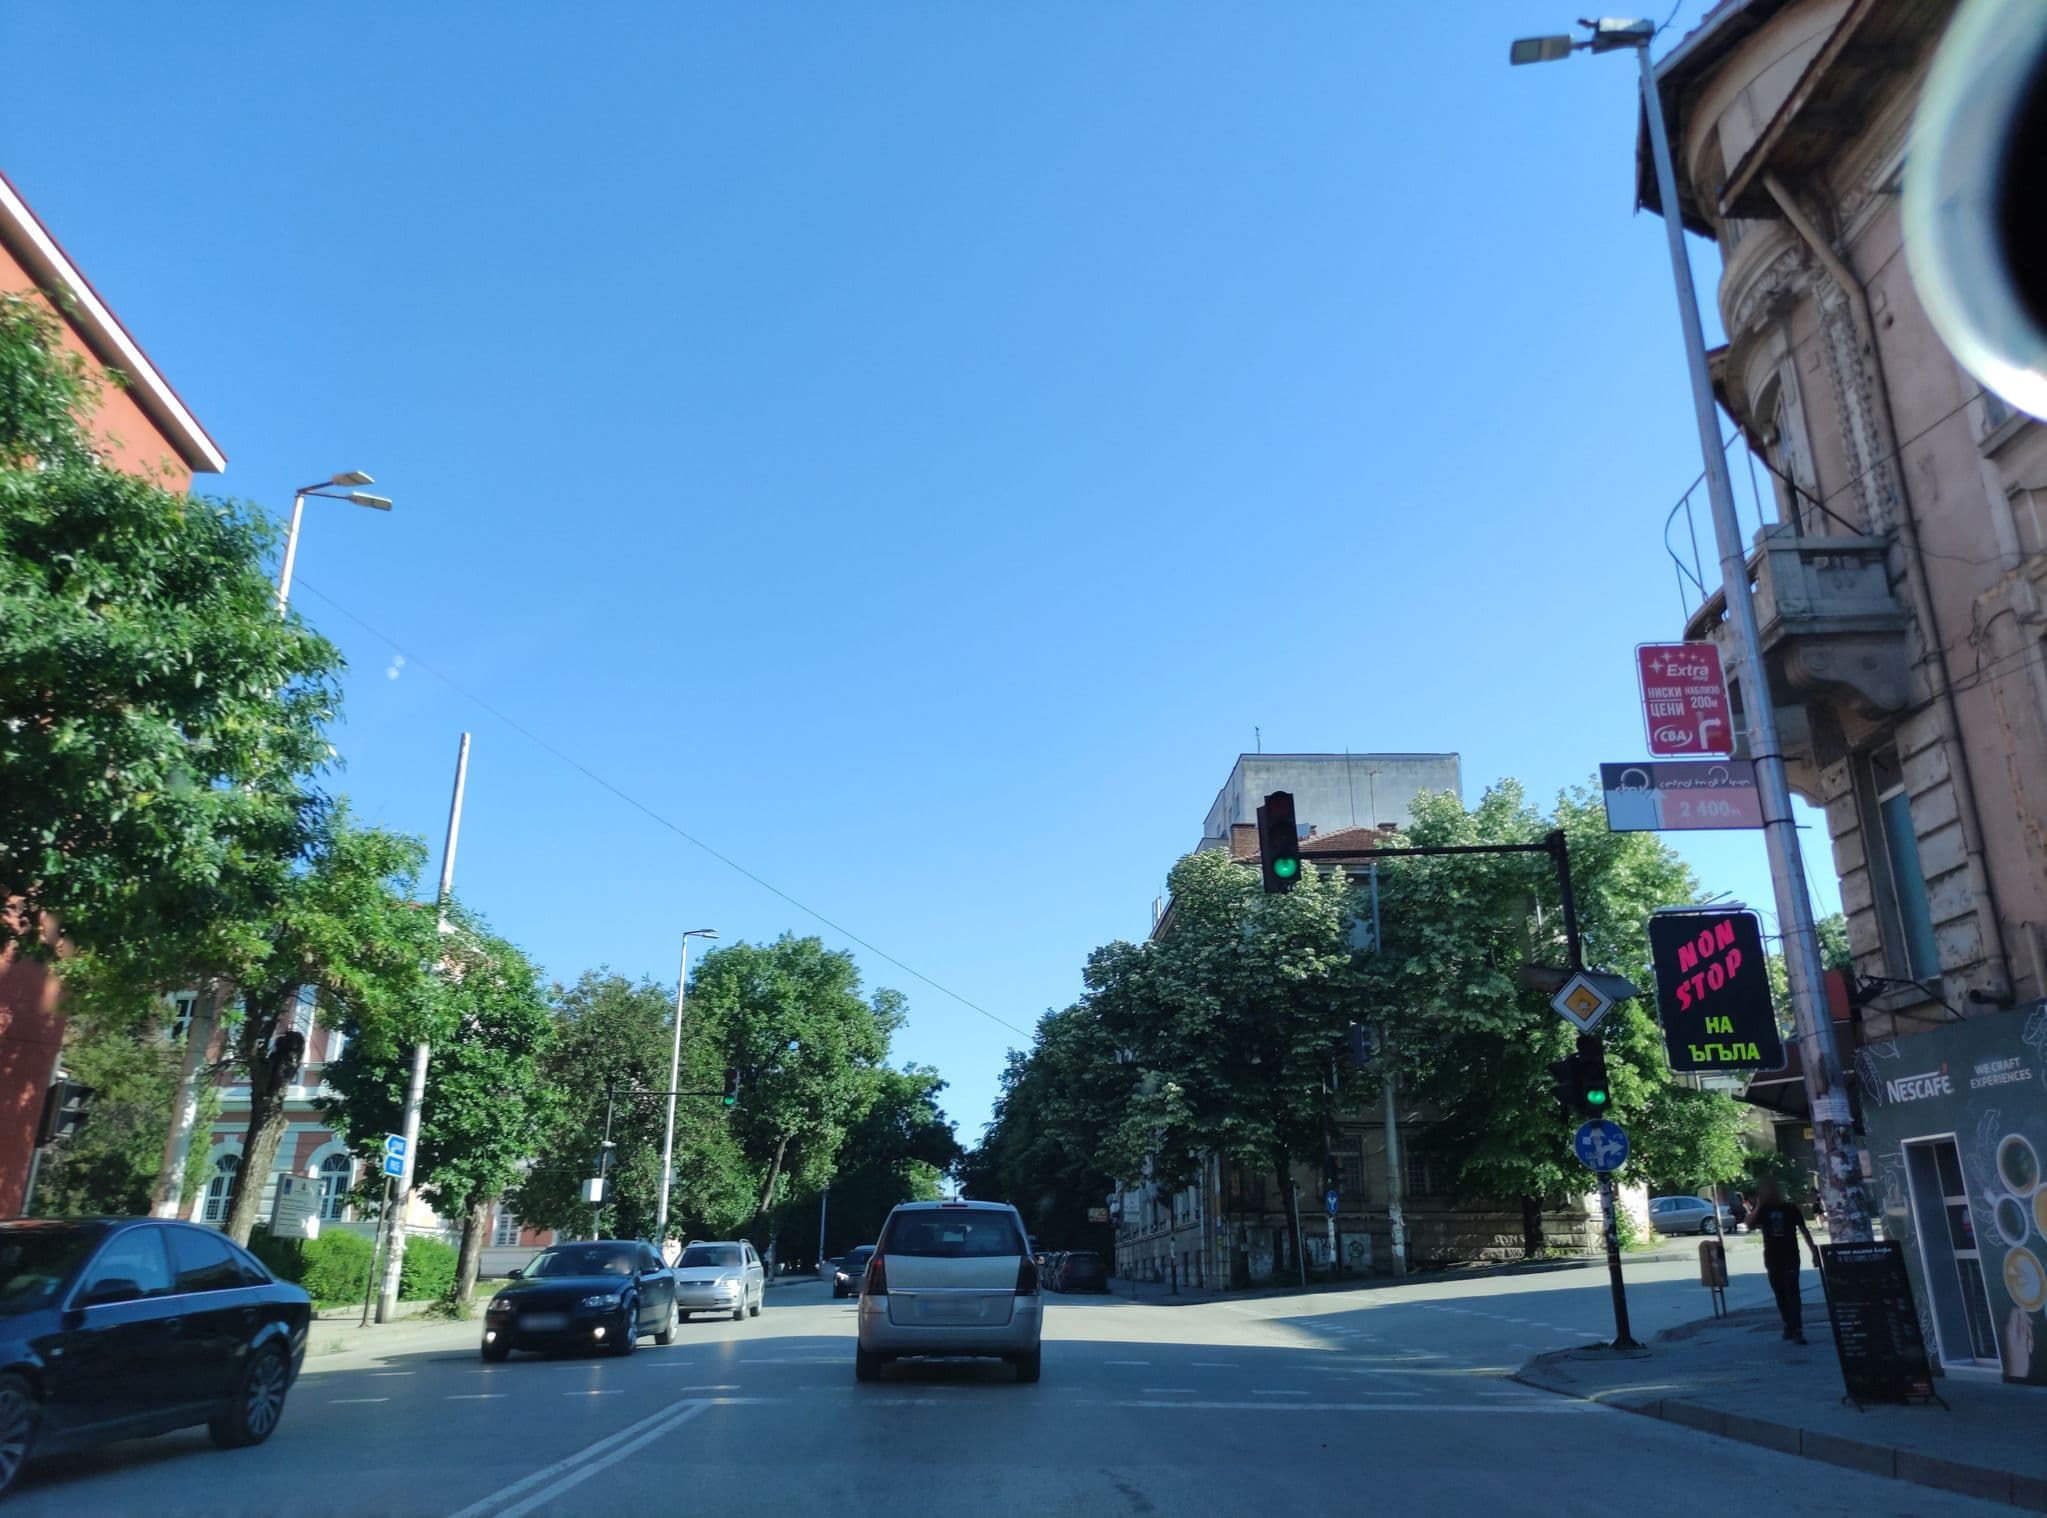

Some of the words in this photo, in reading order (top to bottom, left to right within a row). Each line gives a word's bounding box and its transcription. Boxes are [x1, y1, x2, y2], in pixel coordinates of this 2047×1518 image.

[1666, 664, 1709, 677] Extra
[1647, 687, 1683, 699] НИСКИ
[1650, 702, 1685, 718] ЦЕНИ
[1676, 919, 1736, 973] NON
[1675, 948, 1743, 1012] STOP
[1705, 1016, 1734, 1034] НА
[1688, 1042, 1761, 1063] ЪГЪЛА
[1974, 1063, 1990, 1076] WE
[1991, 1057, 2021, 1073] CRAFT
[1969, 1068, 2033, 1089] EXPERIENCES
